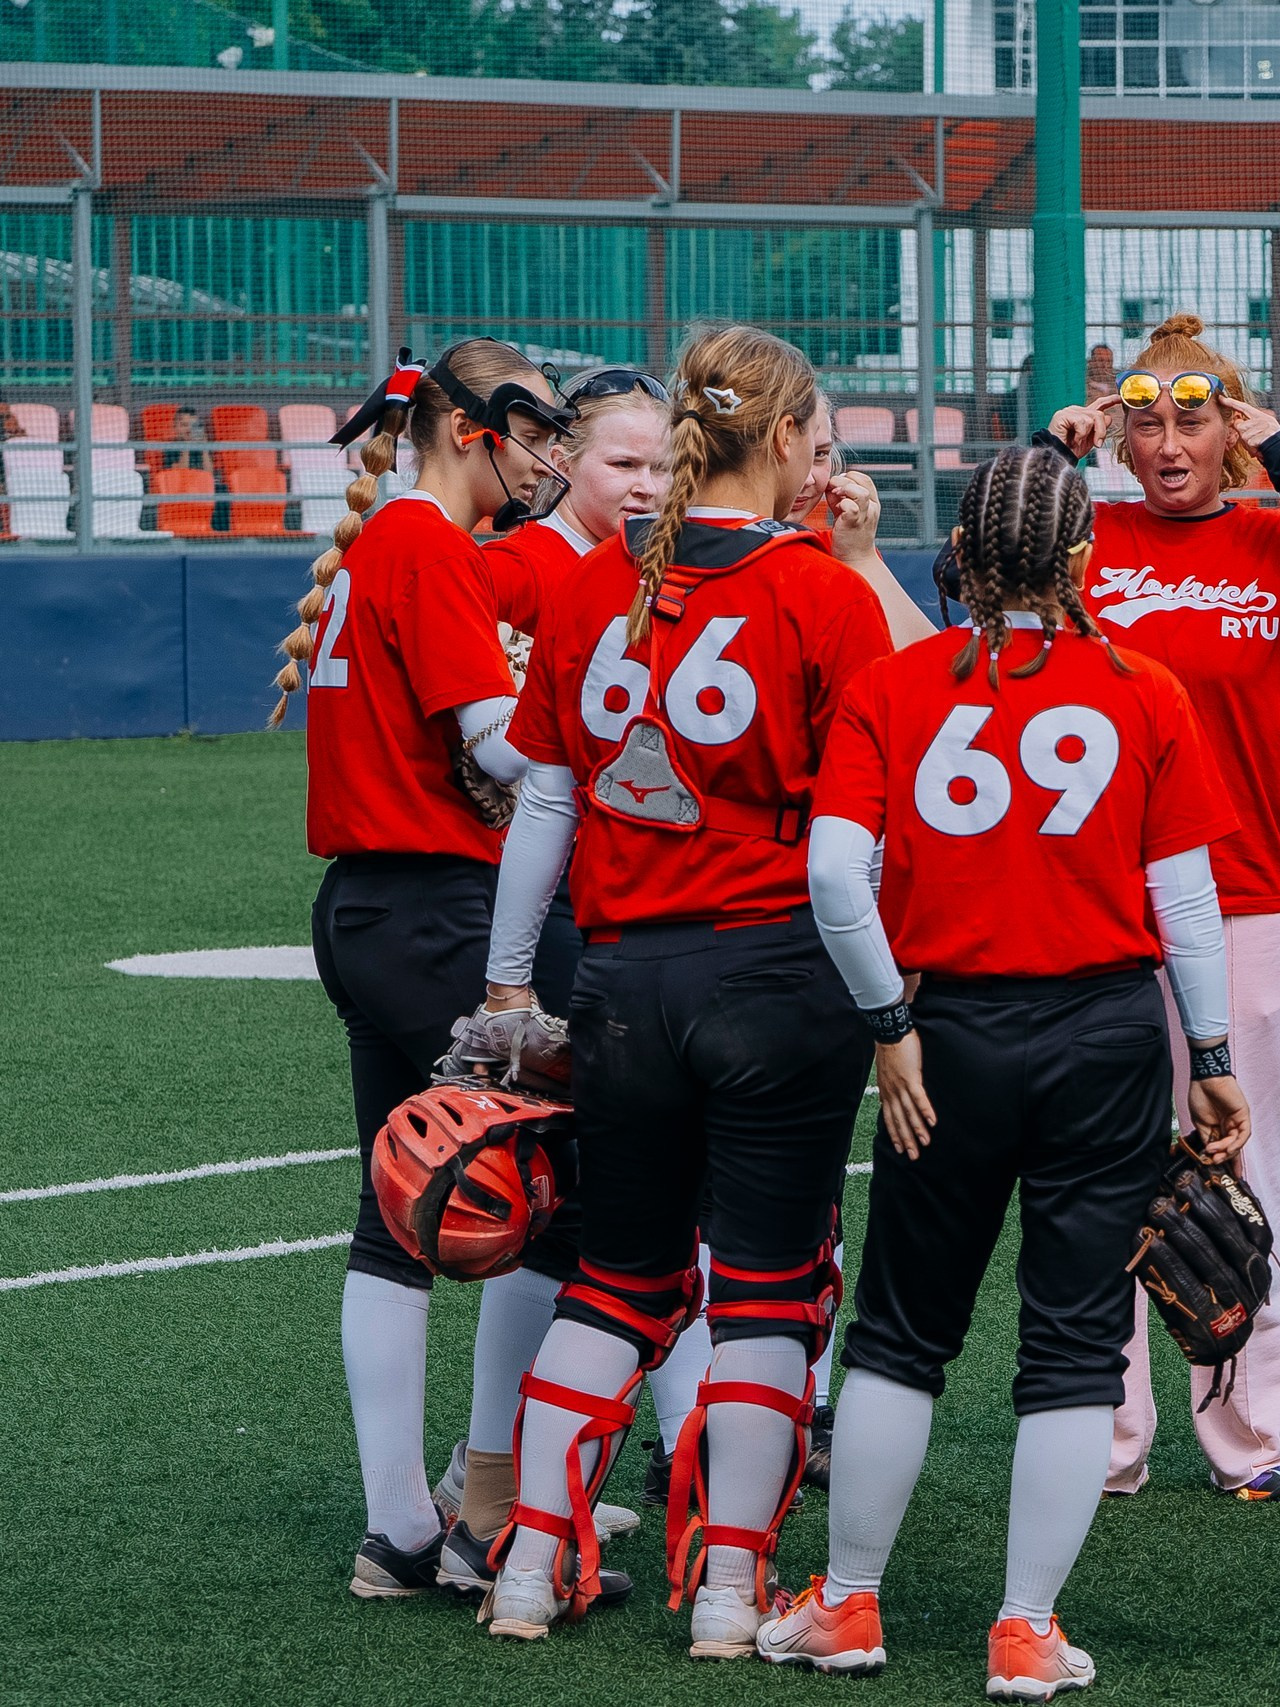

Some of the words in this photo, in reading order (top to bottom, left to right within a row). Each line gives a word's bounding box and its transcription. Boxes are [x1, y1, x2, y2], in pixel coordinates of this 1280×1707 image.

[1221, 615, 1280, 641] RYU
[580, 615, 757, 745] 66
[913, 704, 1120, 836] 69
[1220, 1174, 1264, 1226] Rawlings
